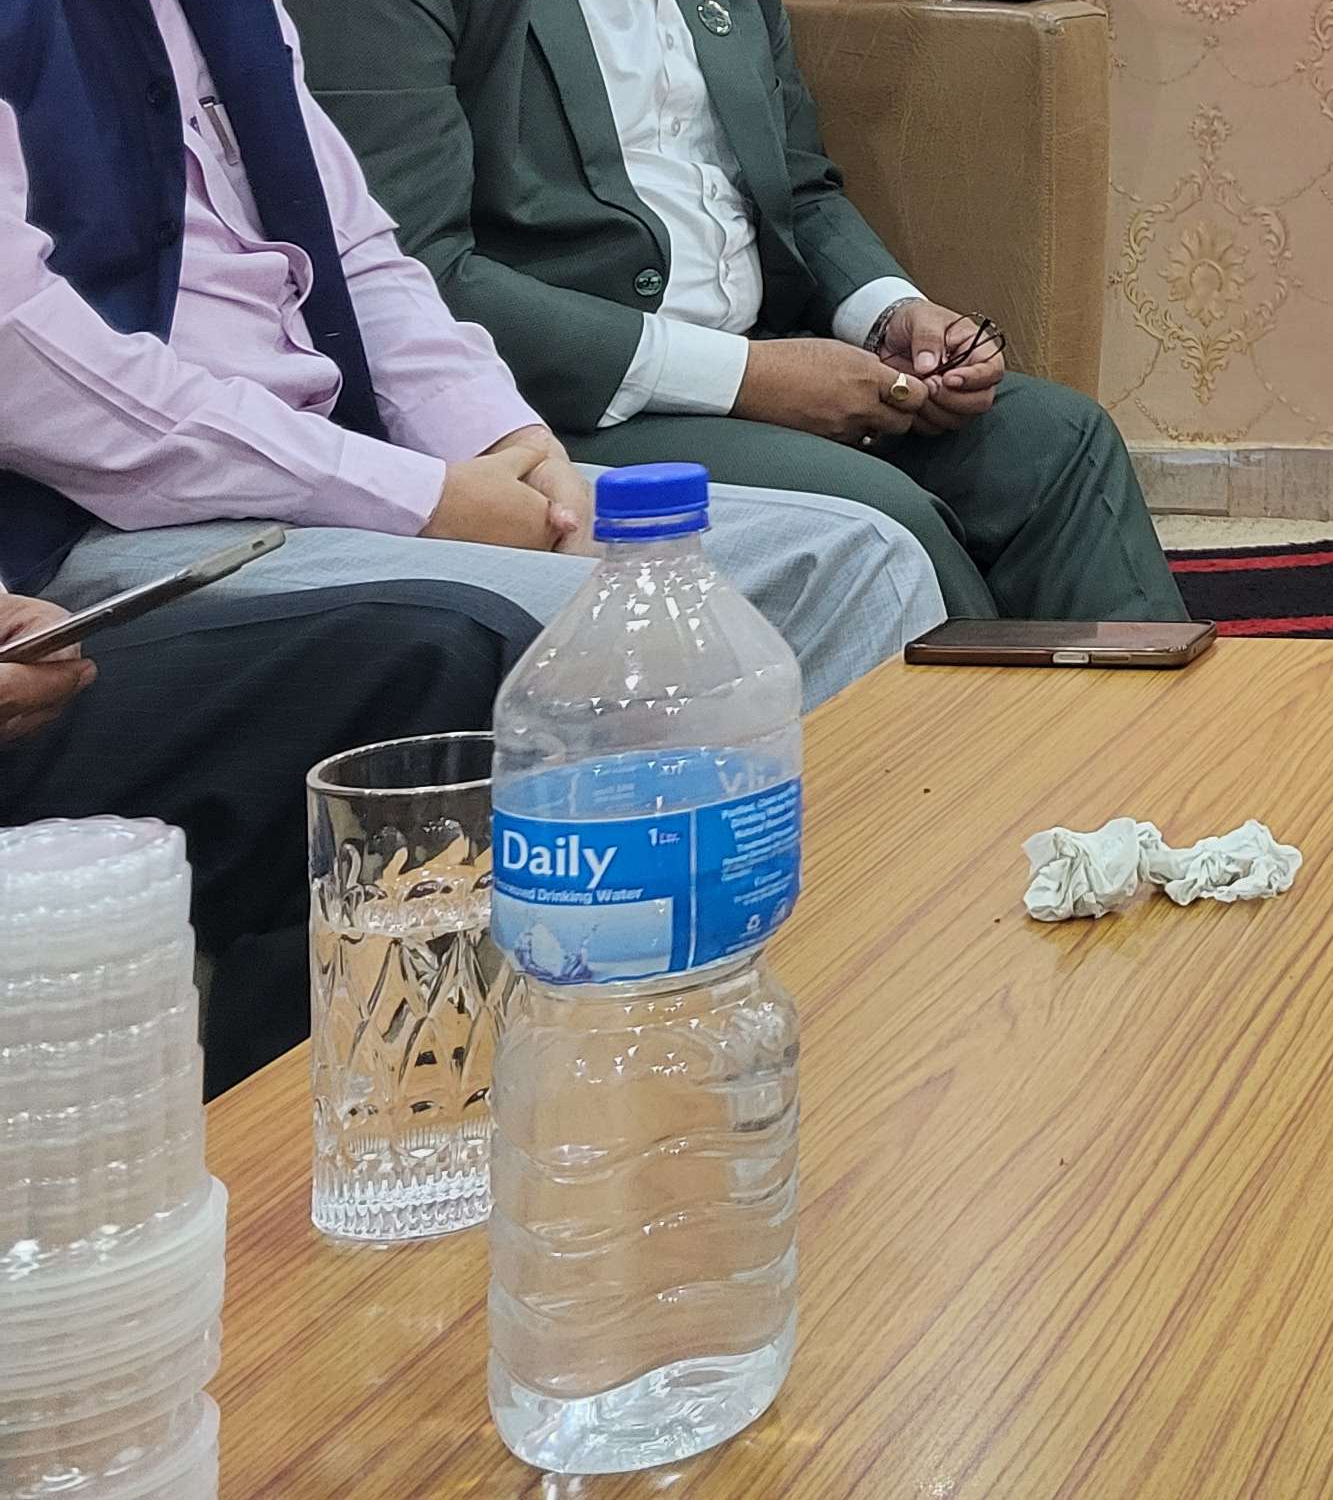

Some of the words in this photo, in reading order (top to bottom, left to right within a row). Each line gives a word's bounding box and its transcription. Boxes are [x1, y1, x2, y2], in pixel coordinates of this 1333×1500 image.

[648, 827, 658, 847] 1
[502, 829, 619, 891] Daily
[537, 888, 594, 905] Drinking
[595, 887, 645, 903] Water
